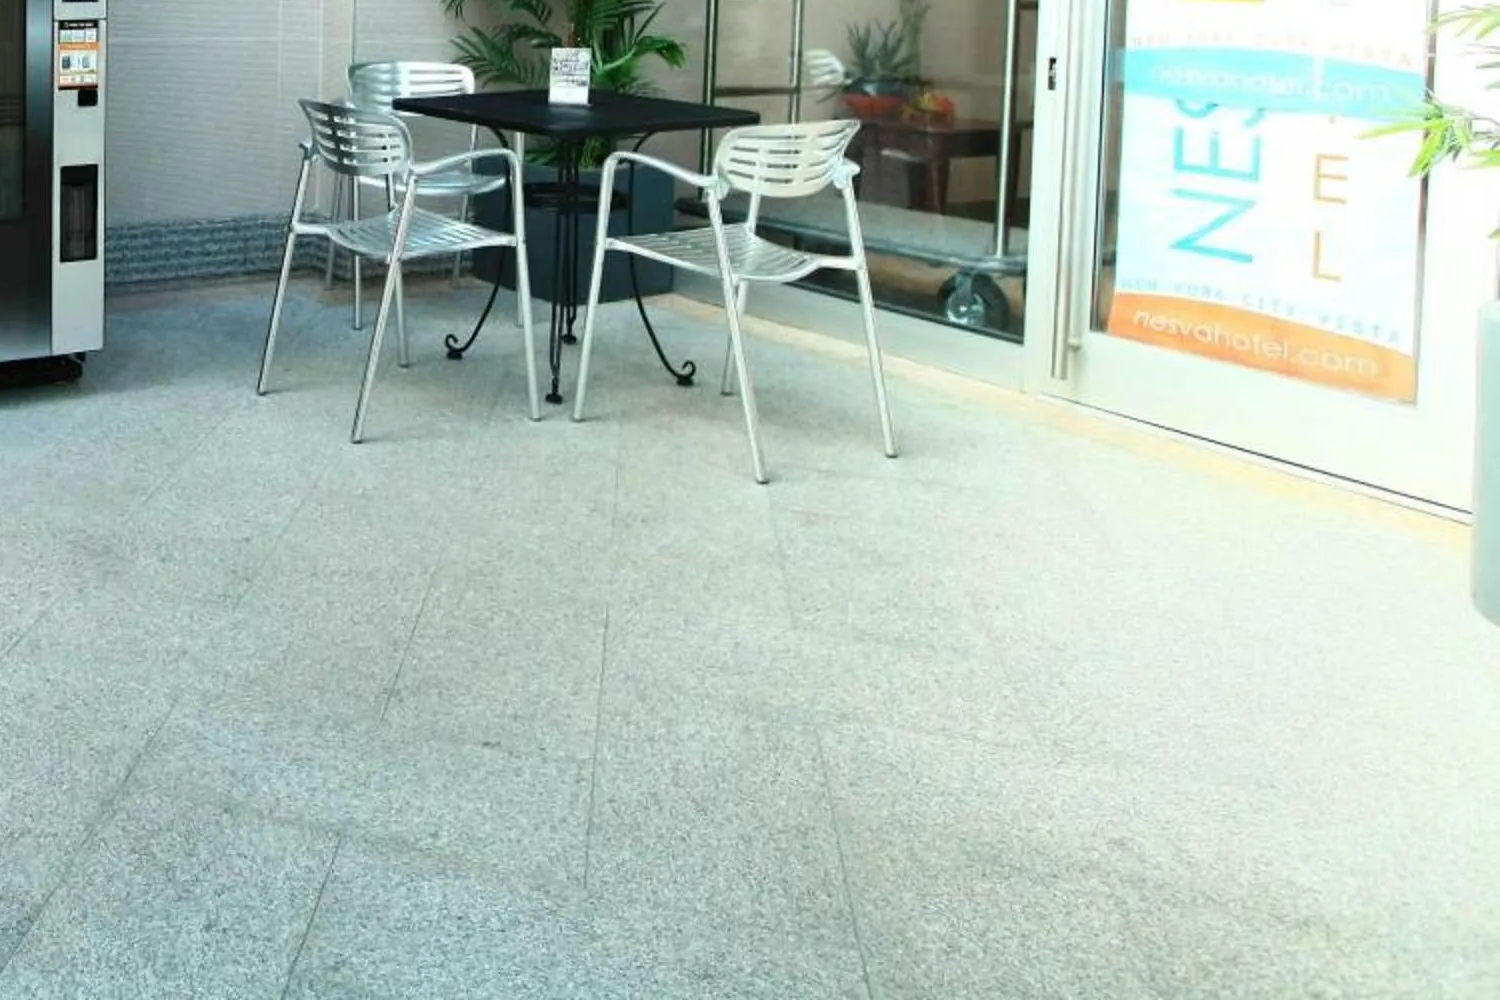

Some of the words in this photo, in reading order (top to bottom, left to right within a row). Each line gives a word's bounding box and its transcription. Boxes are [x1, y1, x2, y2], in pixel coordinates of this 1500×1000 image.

[1132, 310, 1379, 378] nesvahotel.com
[1174, 282, 1225, 301] YORK
[1241, 291, 1297, 317] CITY
[1318, 313, 1401, 344] VISTA
